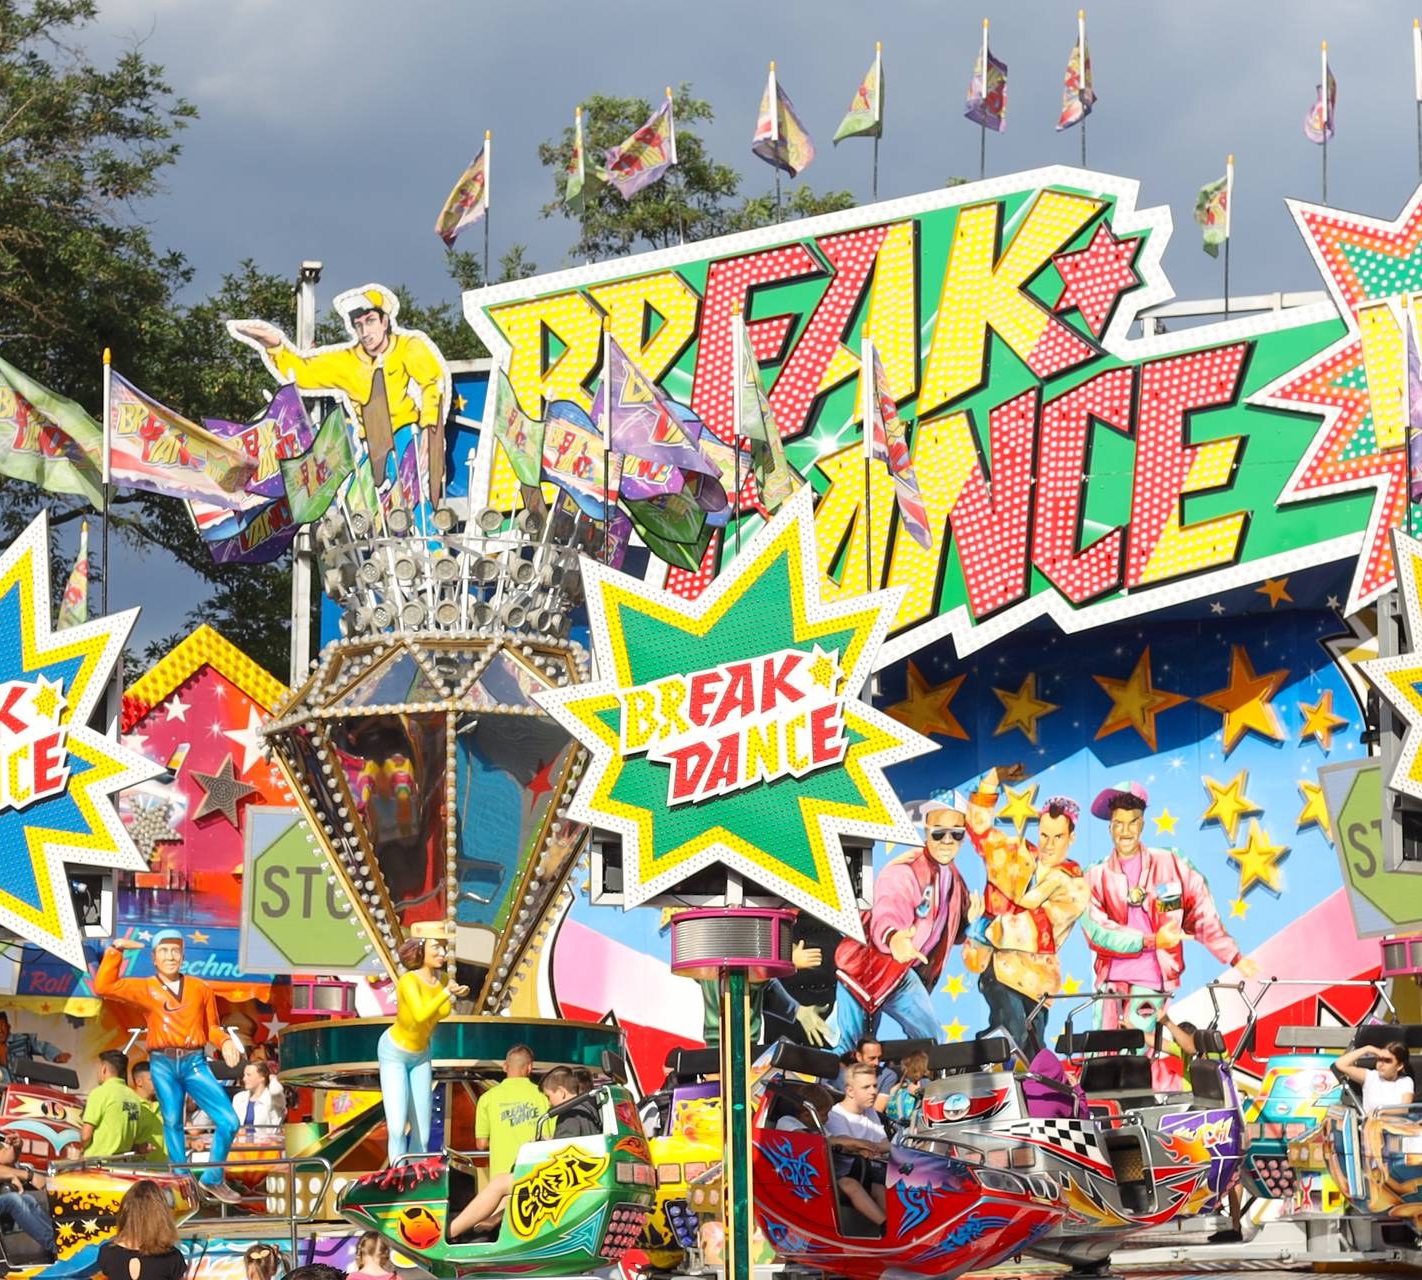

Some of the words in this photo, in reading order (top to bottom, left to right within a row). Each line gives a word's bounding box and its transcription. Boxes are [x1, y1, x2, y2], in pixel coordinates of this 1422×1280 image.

[666, 341, 1252, 632] ANCE
[622, 652, 807, 750] BREAK
[661, 702, 843, 799] DANCE
[261, 865, 355, 920] STO
[29, 970, 73, 993] Roll
[179, 952, 247, 978] echno
